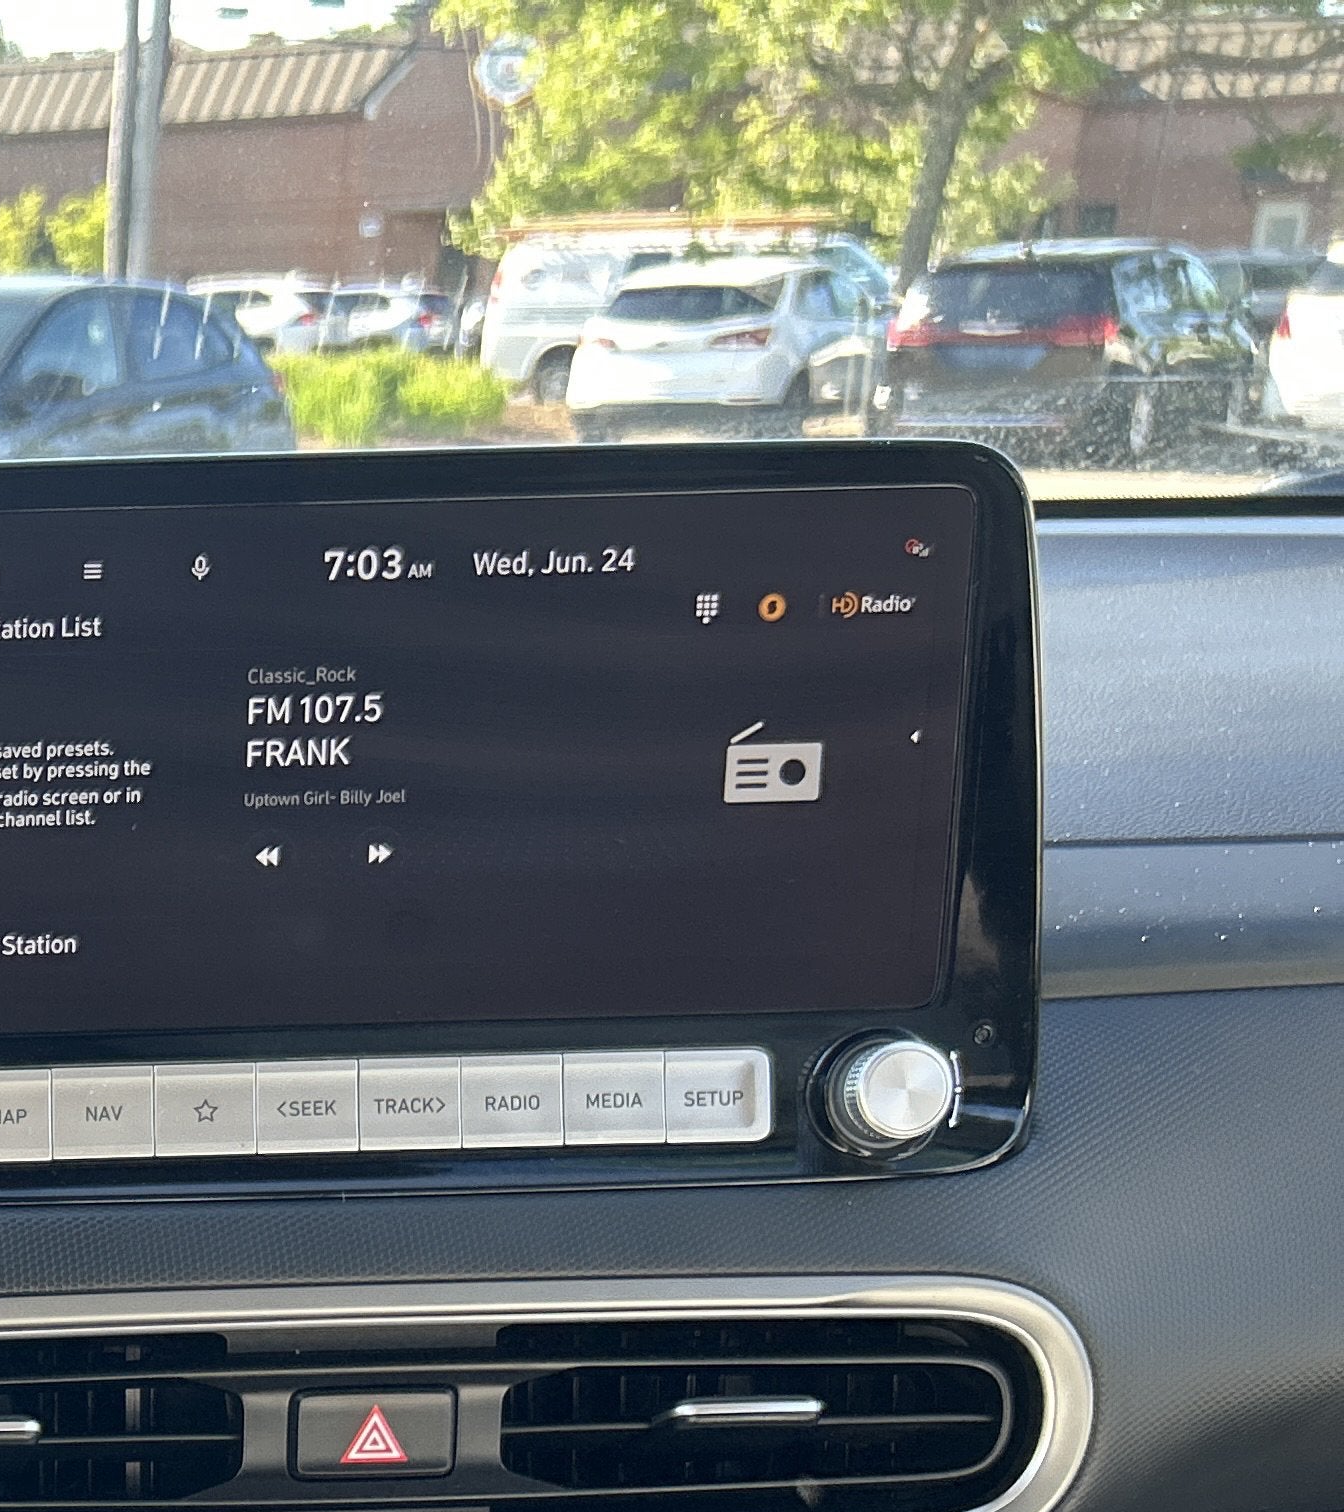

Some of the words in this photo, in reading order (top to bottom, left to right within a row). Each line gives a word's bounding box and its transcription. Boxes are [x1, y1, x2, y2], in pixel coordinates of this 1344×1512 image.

[324, 548, 404, 580] 7:03
[408, 562, 433, 579] AM
[473, 551, 534, 578] Wed,
[541, 549, 593, 574] Jun.
[602, 547, 635, 573] 24
[61, 617, 102, 638] List
[248, 666, 356, 686] Classic_Rock
[247, 698, 291, 725] FM
[300, 694, 384, 723] 107.5
[46, 741, 114, 761] presets.
[245, 737, 351, 768] FRANK
[23, 763, 42, 782] by
[46, 761, 119, 782] pressing
[124, 759, 151, 776] the
[43, 790, 99, 806] screen
[104, 790, 121, 804] or
[126, 788, 141, 804] in
[243, 792, 300, 809] Uptown
[340, 790, 372, 806] Billy
[375, 789, 406, 803] Joel
[65, 808, 96, 825] list.
[1, 935, 77, 956] Station
[485, 1095, 540, 1113] RADIO
[585, 1092, 643, 1110] MEDIA
[684, 1090, 744, 1108] SETUP
[85, 1105, 123, 1122] NAV
